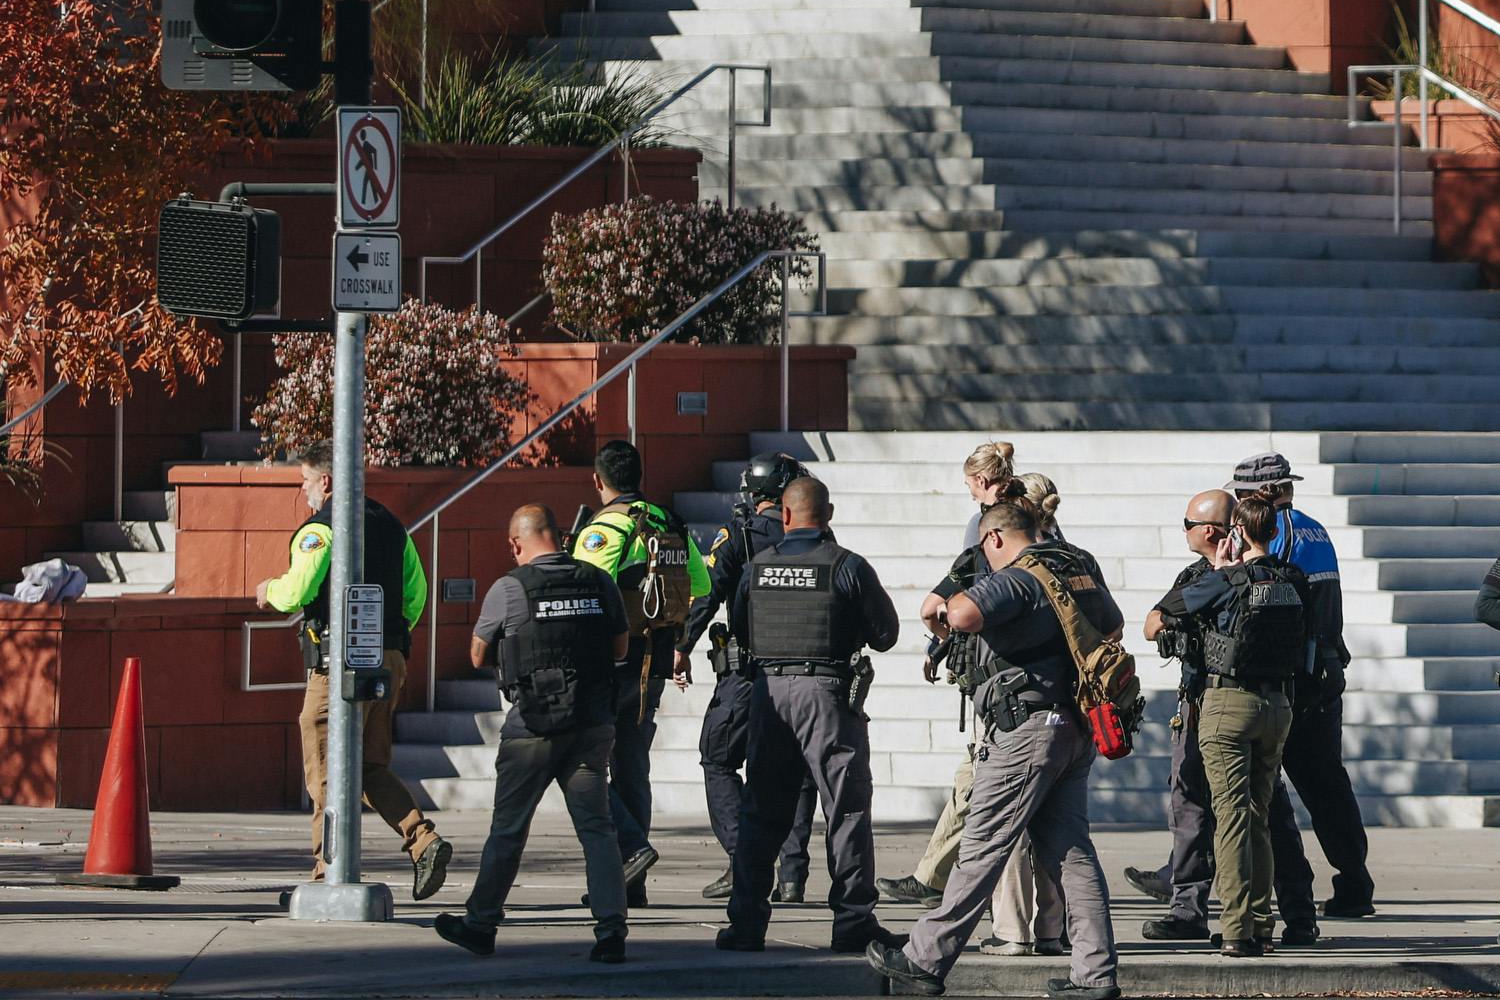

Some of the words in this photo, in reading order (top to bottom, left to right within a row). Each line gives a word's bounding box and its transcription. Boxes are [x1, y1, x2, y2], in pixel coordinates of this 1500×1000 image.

[373, 251, 390, 267] USE
[340, 278, 394, 294] CROSSWALK
[1293, 528, 1329, 543] POLIC
[763, 567, 814, 577] STATE
[758, 577, 817, 587] POLICE
[538, 598, 600, 611] POLICE
